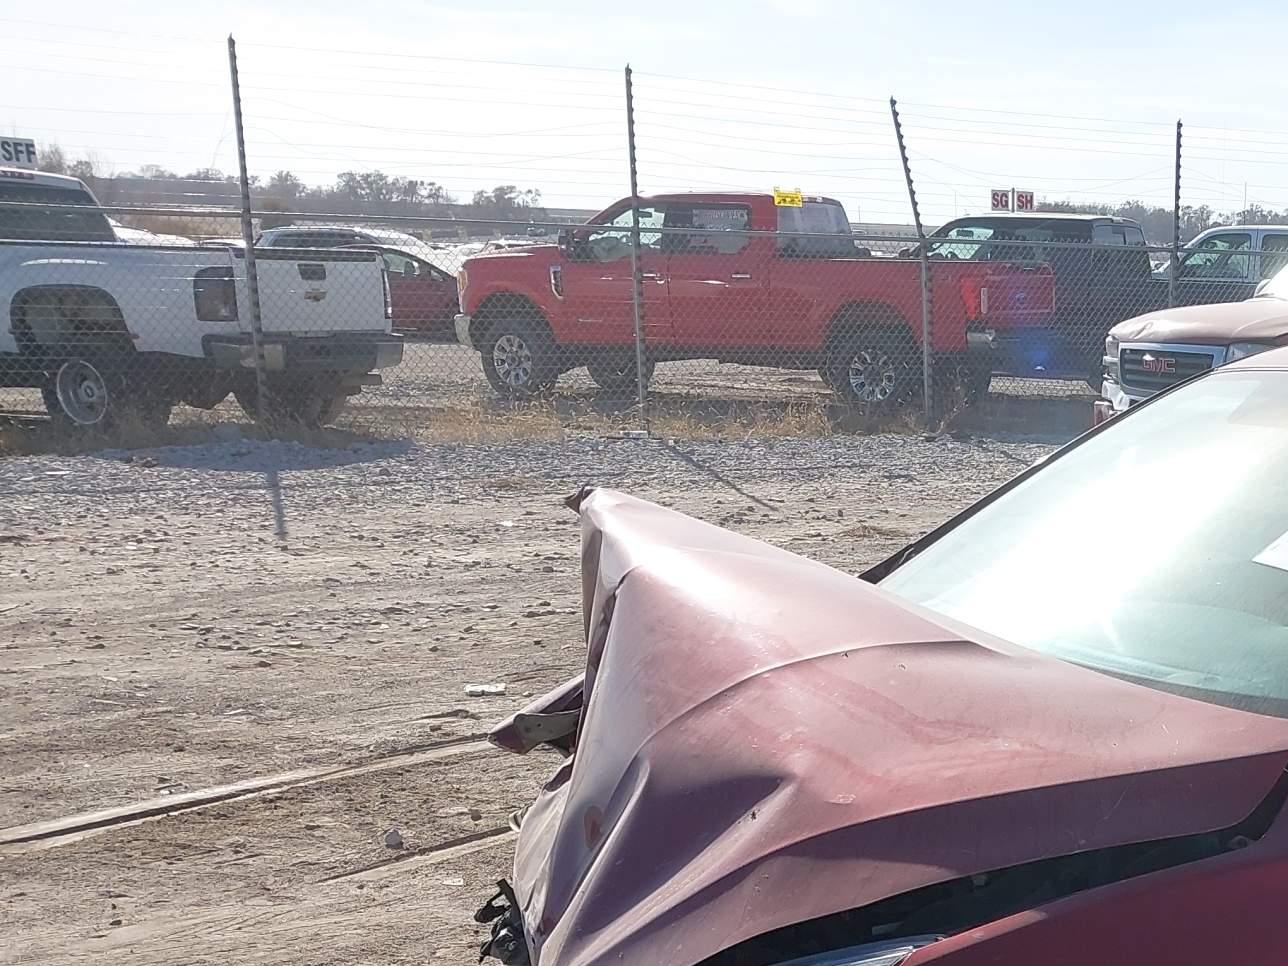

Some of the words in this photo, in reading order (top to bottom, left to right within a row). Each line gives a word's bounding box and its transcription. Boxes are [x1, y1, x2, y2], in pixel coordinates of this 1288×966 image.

[1, 140, 36, 163] SFF
[992, 192, 1009, 208] SG
[1017, 193, 1033, 210] SH
[1143, 357, 1176, 373] GMC
